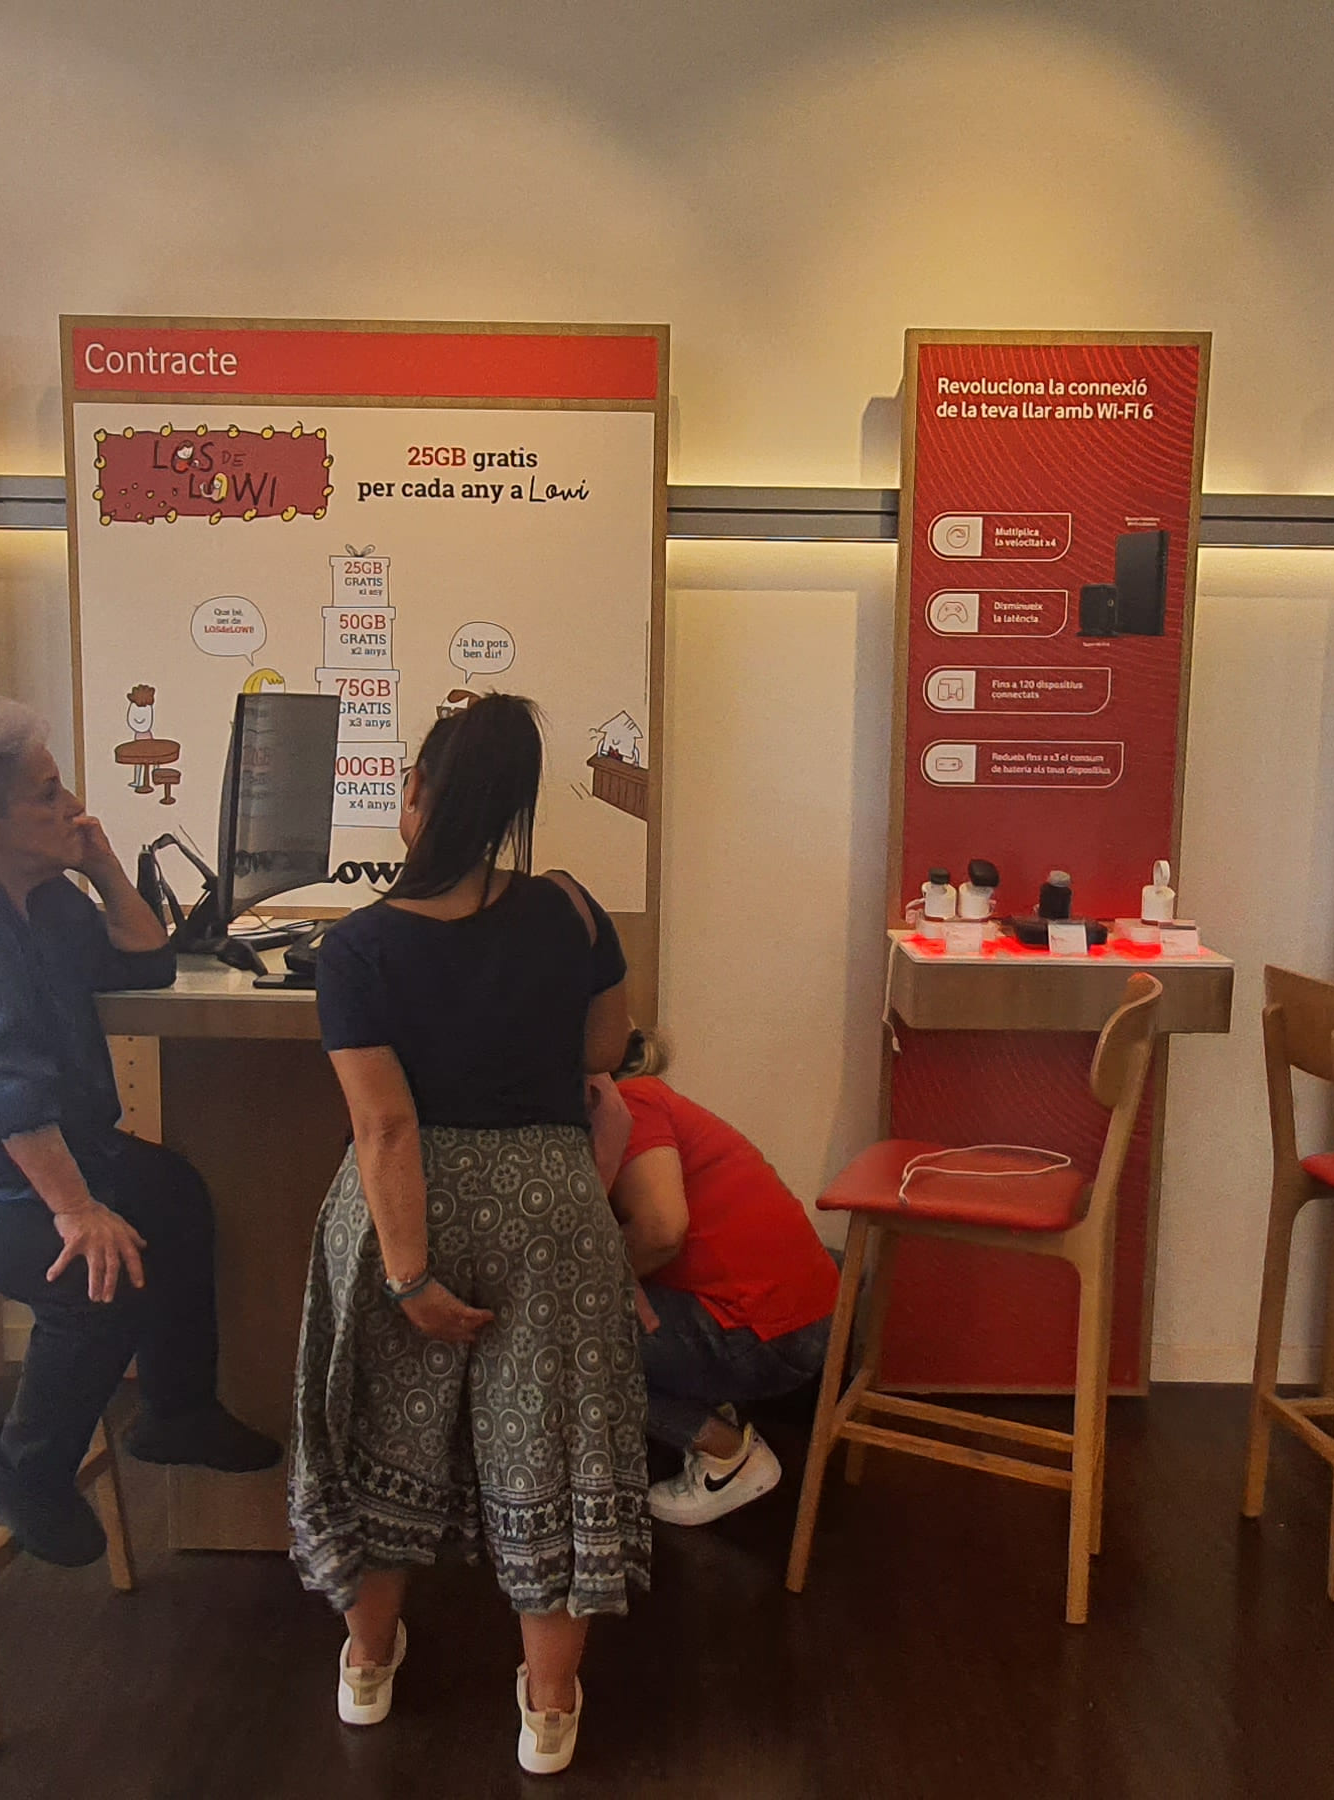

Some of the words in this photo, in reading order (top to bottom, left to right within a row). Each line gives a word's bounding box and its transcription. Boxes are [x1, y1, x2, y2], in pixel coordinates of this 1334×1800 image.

[85, 344, 238, 376] Contracte
[938, 378, 1045, 396] Revoluciona
[1049, 378, 1065, 396] la
[1068, 378, 1148, 396] connexió
[936, 402, 958, 418] de
[961, 402, 977, 418] la
[981, 403, 1018, 419] teva
[1022, 403, 1052, 419] llar
[1055, 403, 1094, 419] amb
[1097, 403, 1139, 420] Wi-Fi
[1142, 403, 1154, 420] 6
[222, 450, 247, 467] DE
[407, 446, 466, 467] 25GB
[472, 447, 538, 472] gratis
[357, 481, 395, 502] per
[401, 478, 454, 499] cada
[461, 483, 504, 504] any
[510, 484, 524, 500] a
[529, 475, 589, 502] Lowi
[994, 527, 1040, 538] Multiplica
[343, 561, 383, 575] 25GB
[344, 577, 383, 587] GRATIS
[339, 613, 387, 630] 50GB
[339, 633, 387, 645] GRATIS
[456, 637, 468, 648] Ja
[471, 637, 484, 648] ho
[486, 639, 509, 651] pots
[350, 647, 362, 656] x2
[463, 648, 482, 658] ben
[334, 678, 392, 698] 75GB
[349, 718, 362, 728] x3
[365, 718, 392, 730] anys
[335, 756, 396, 777] 00GB
[335, 781, 396, 796] GRATIS
[349, 799, 364, 809] x4
[367, 800, 396, 812] anys
